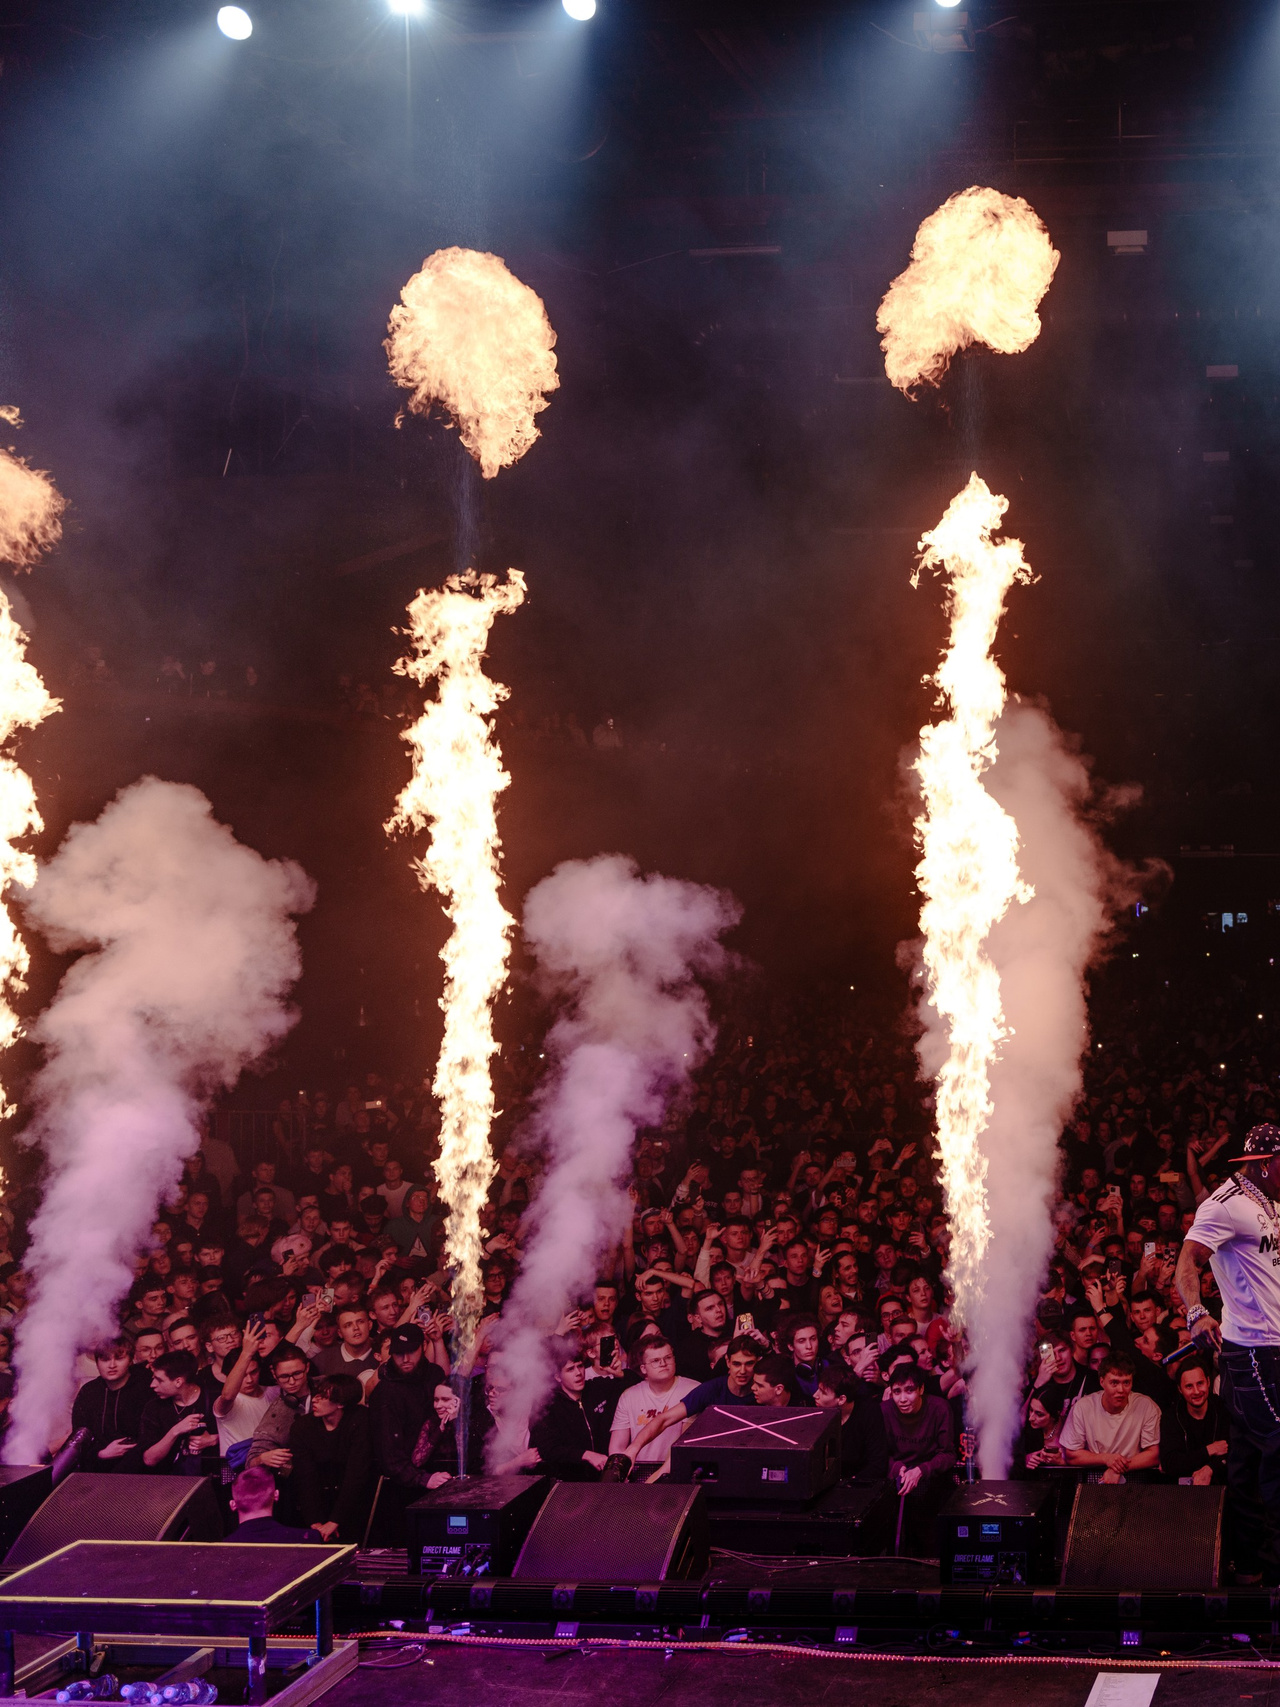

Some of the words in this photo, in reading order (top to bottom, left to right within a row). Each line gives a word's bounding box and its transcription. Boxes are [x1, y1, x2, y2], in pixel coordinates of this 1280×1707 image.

[422, 1545, 442, 1554] DIRECT
[442, 1546, 462, 1555] FLAME
[953, 1554, 975, 1563] DIRECT
[975, 1554, 995, 1563] FLAME
